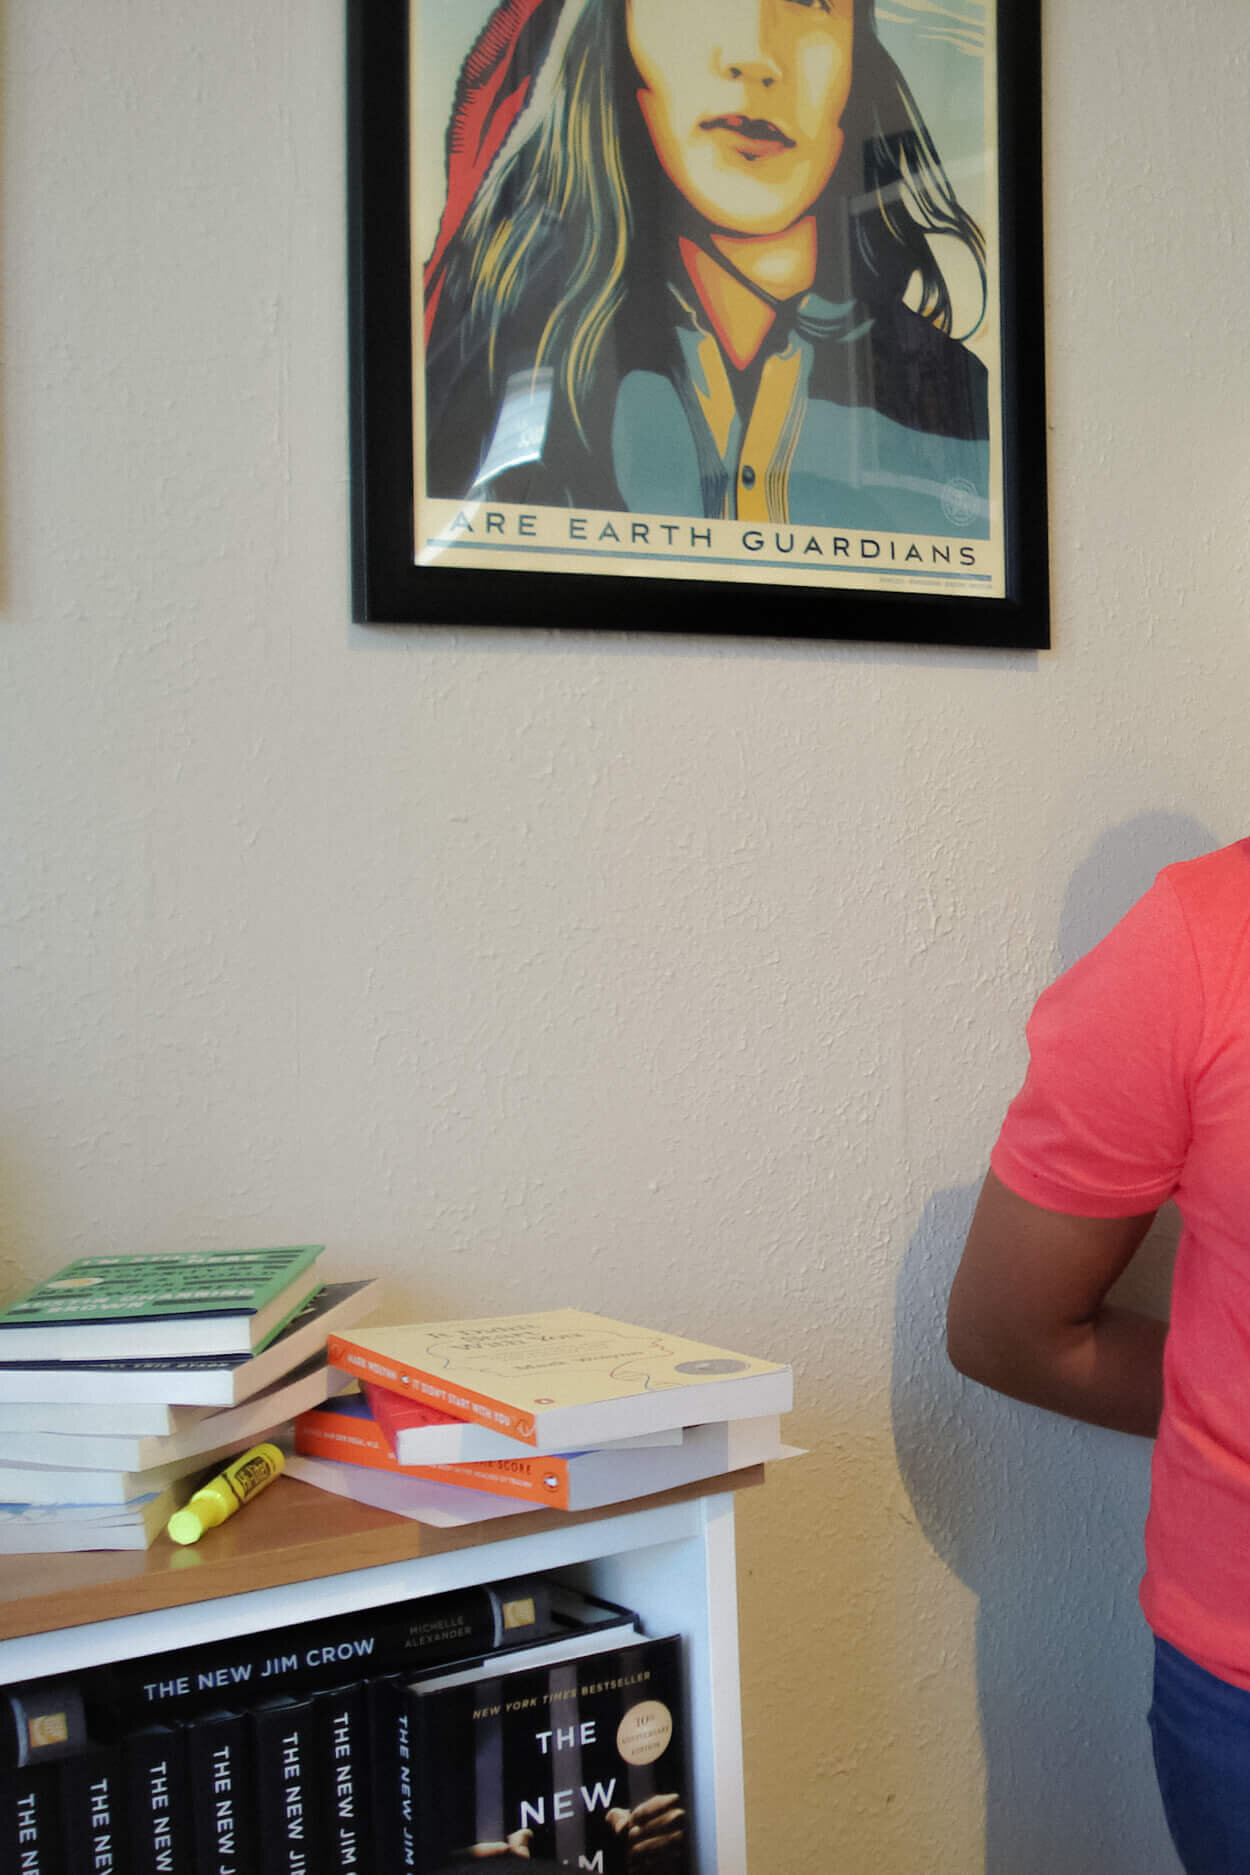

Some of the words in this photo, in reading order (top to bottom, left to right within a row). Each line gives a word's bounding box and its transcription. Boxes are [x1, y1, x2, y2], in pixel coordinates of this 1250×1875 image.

[449, 511, 538, 536] ARE
[569, 518, 713, 549] EARTH
[742, 530, 977, 567] GUARDIANS
[405, 1626, 472, 1648] ALEXANDER
[410, 1615, 464, 1635] MICHELLE
[143, 1675, 192, 1701] THE
[198, 1662, 252, 1691] NEW
[260, 1652, 299, 1684] JIM
[306, 1637, 376, 1668] CROW
[472, 1706, 500, 1721] NEW
[505, 1697, 537, 1714] YORK
[542, 1687, 577, 1704] TIMES
[581, 1671, 651, 1697] BESTSELLER
[282, 1732, 300, 1780] THE
[333, 1712, 350, 1760] THE
[396, 1714, 410, 1760] THE
[535, 1721, 597, 1755] THE
[150, 1761, 169, 1810] THE
[213, 1746, 231, 1794] THE
[335, 1765, 354, 1819] NEW
[399, 1765, 413, 1822] NEW
[17, 1793, 37, 1844] THE
[90, 1778, 110, 1829] THE
[216, 1800, 236, 1855] NEW
[285, 1786, 304, 1840] NEW
[520, 1778, 616, 1830] NEW
[153, 1816, 174, 1873] NEW
[339, 1828, 358, 1866] JIM
[402, 1826, 415, 1867] JIM
